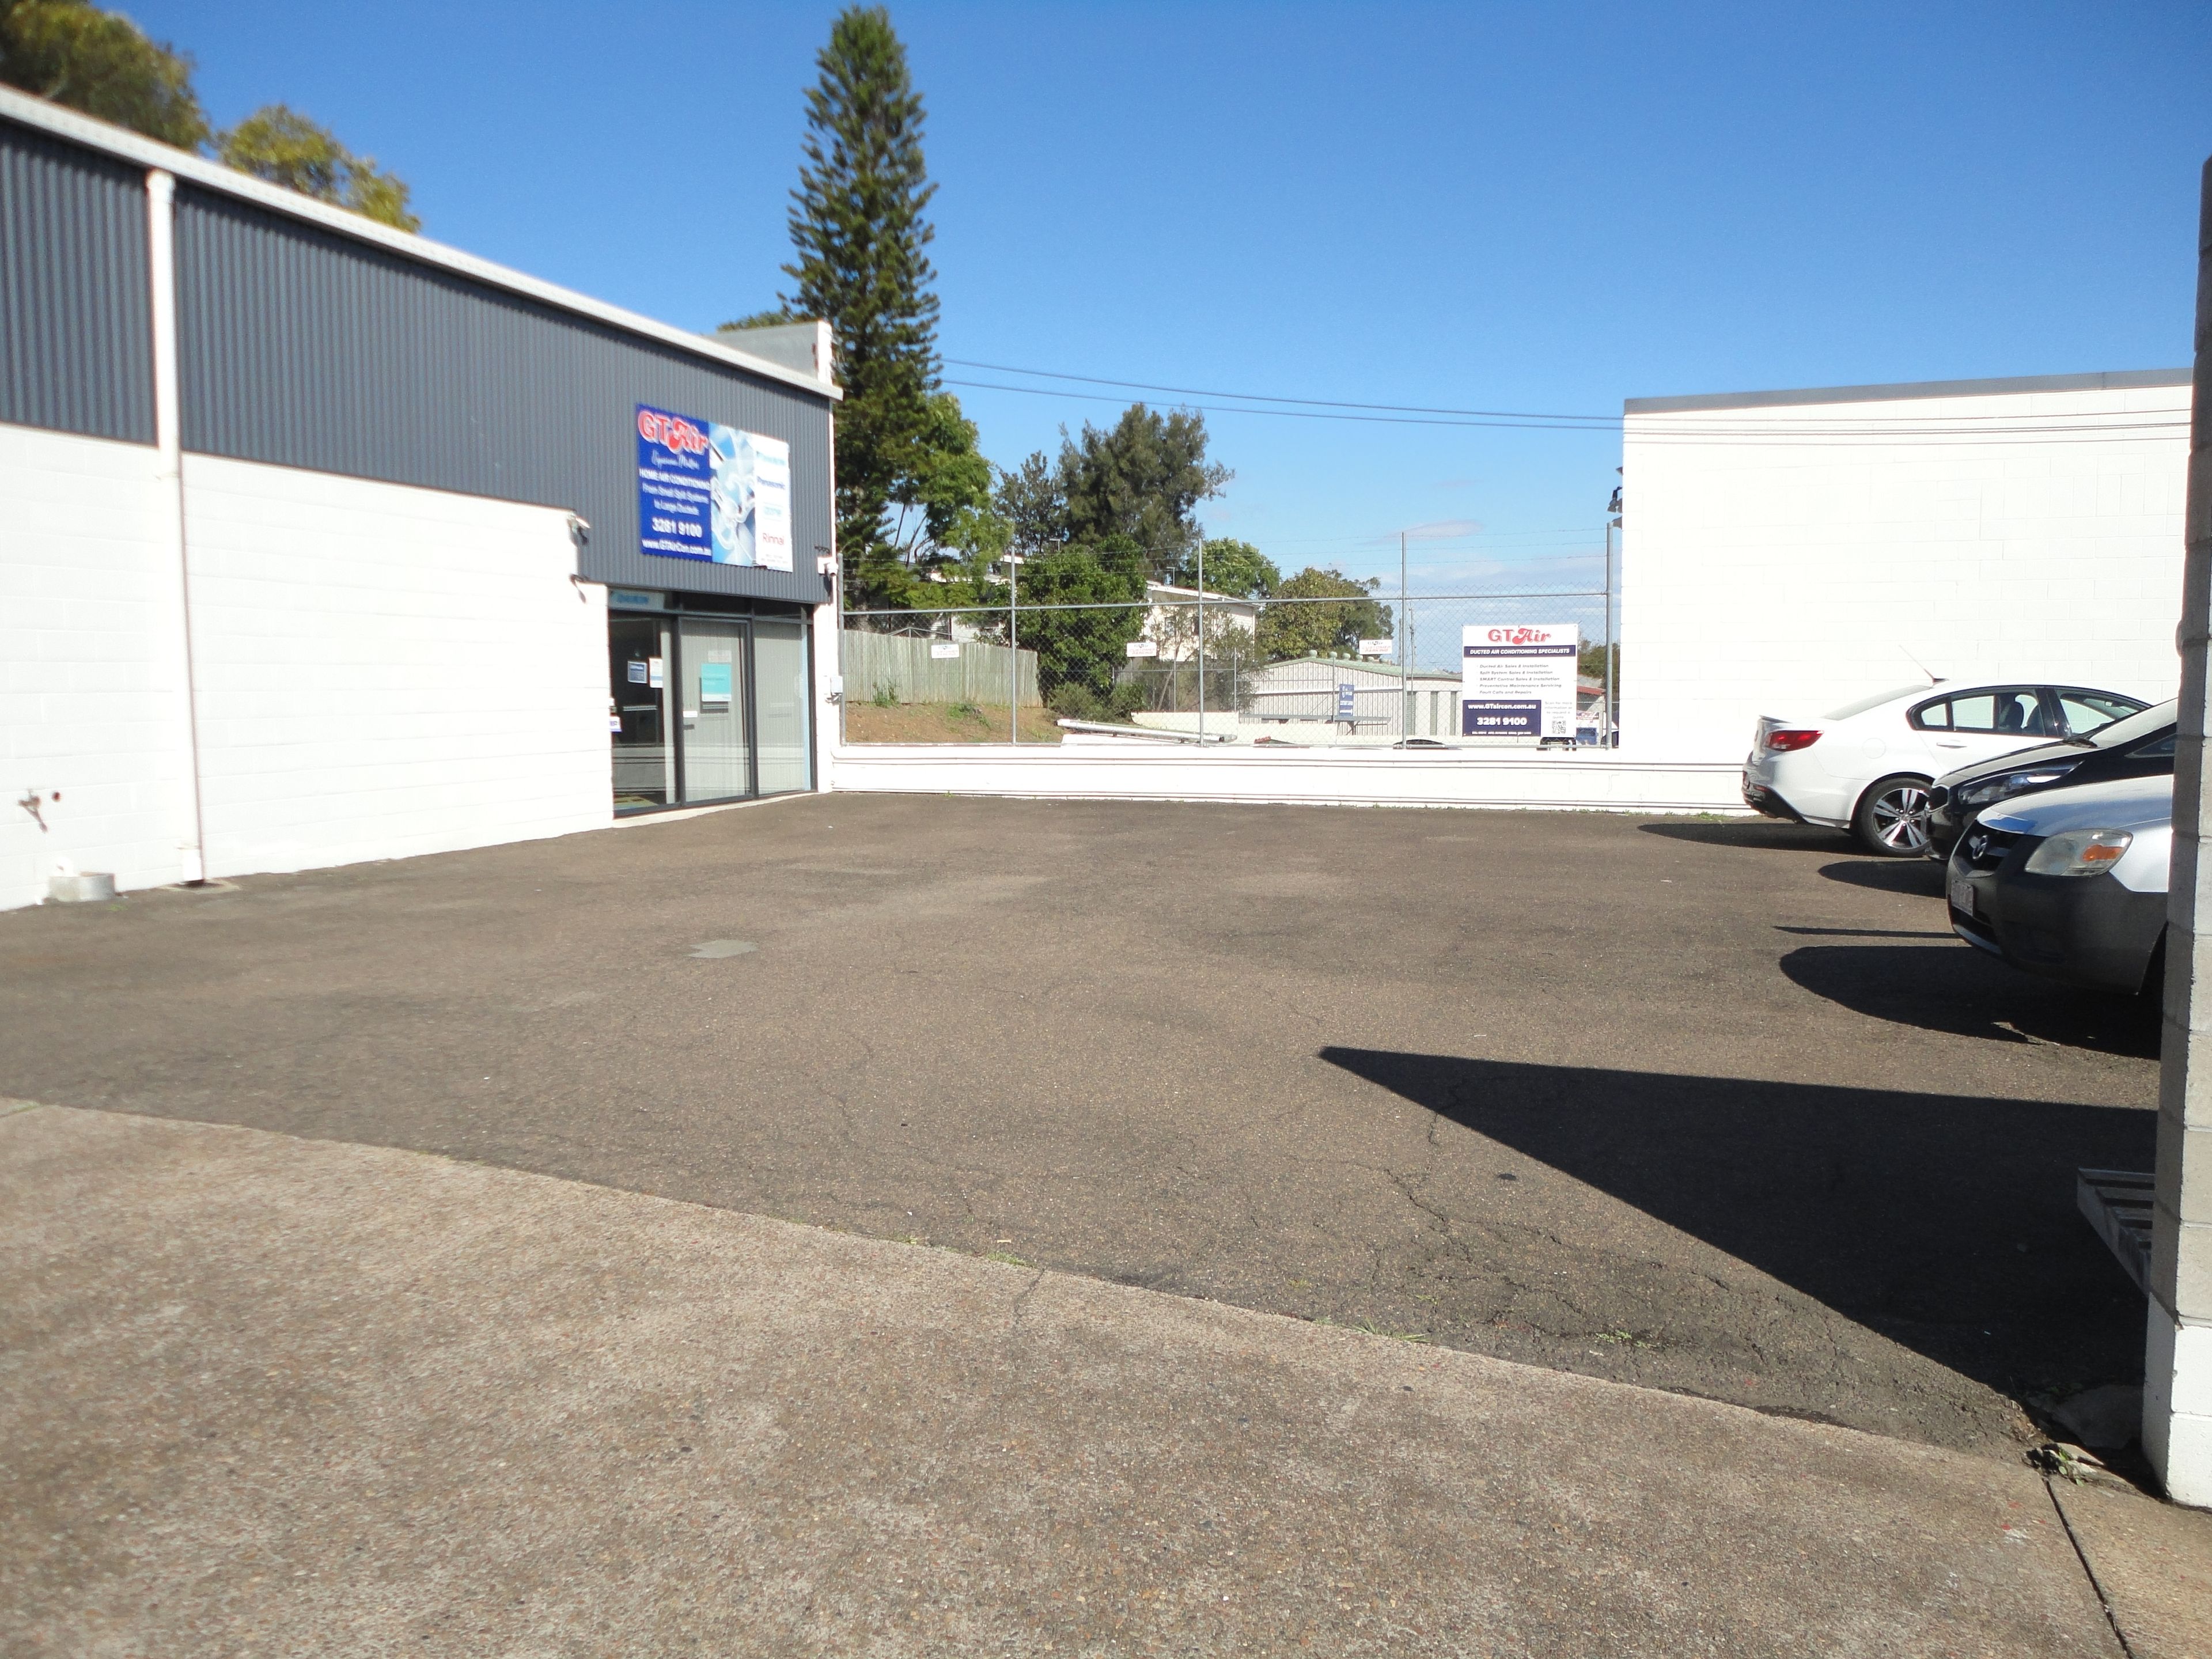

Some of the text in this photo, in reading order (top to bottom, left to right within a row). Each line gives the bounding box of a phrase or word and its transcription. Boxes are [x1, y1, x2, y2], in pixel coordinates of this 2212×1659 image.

[638, 410, 709, 455] GT Air
[669, 474, 710, 491] CONDITIONING
[652, 517, 702, 538] 3281 9100
[763, 532, 785, 546] Rinnai
[1488, 628, 1551, 645] GT Air
[1476, 717, 1527, 726] 3281 9100
